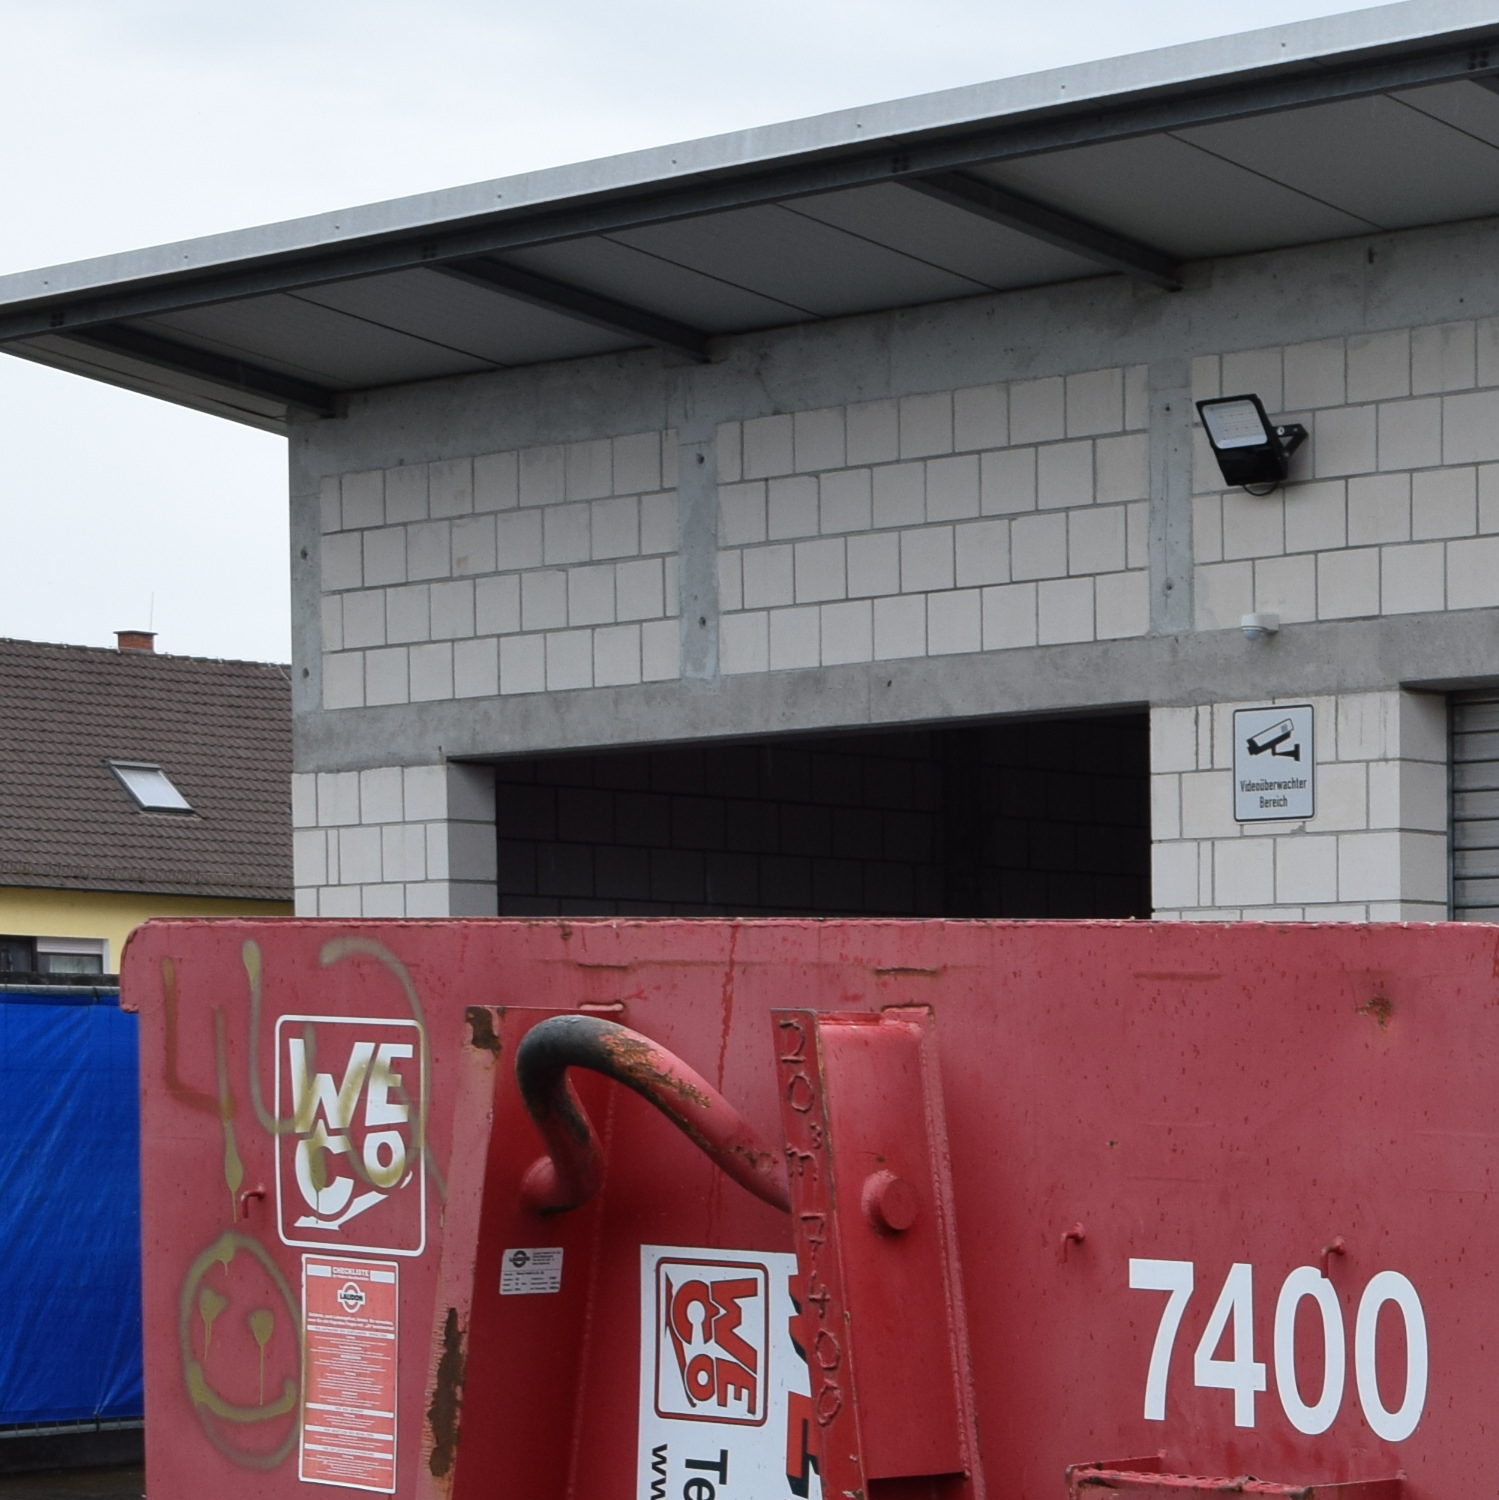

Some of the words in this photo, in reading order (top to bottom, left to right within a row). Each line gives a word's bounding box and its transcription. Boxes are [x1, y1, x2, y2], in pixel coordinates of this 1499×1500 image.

[1240, 777, 1307, 792] Videoüberwachter
[1259, 795, 1288, 808] Bereich
[1128, 1258, 1429, 1442] 7400
